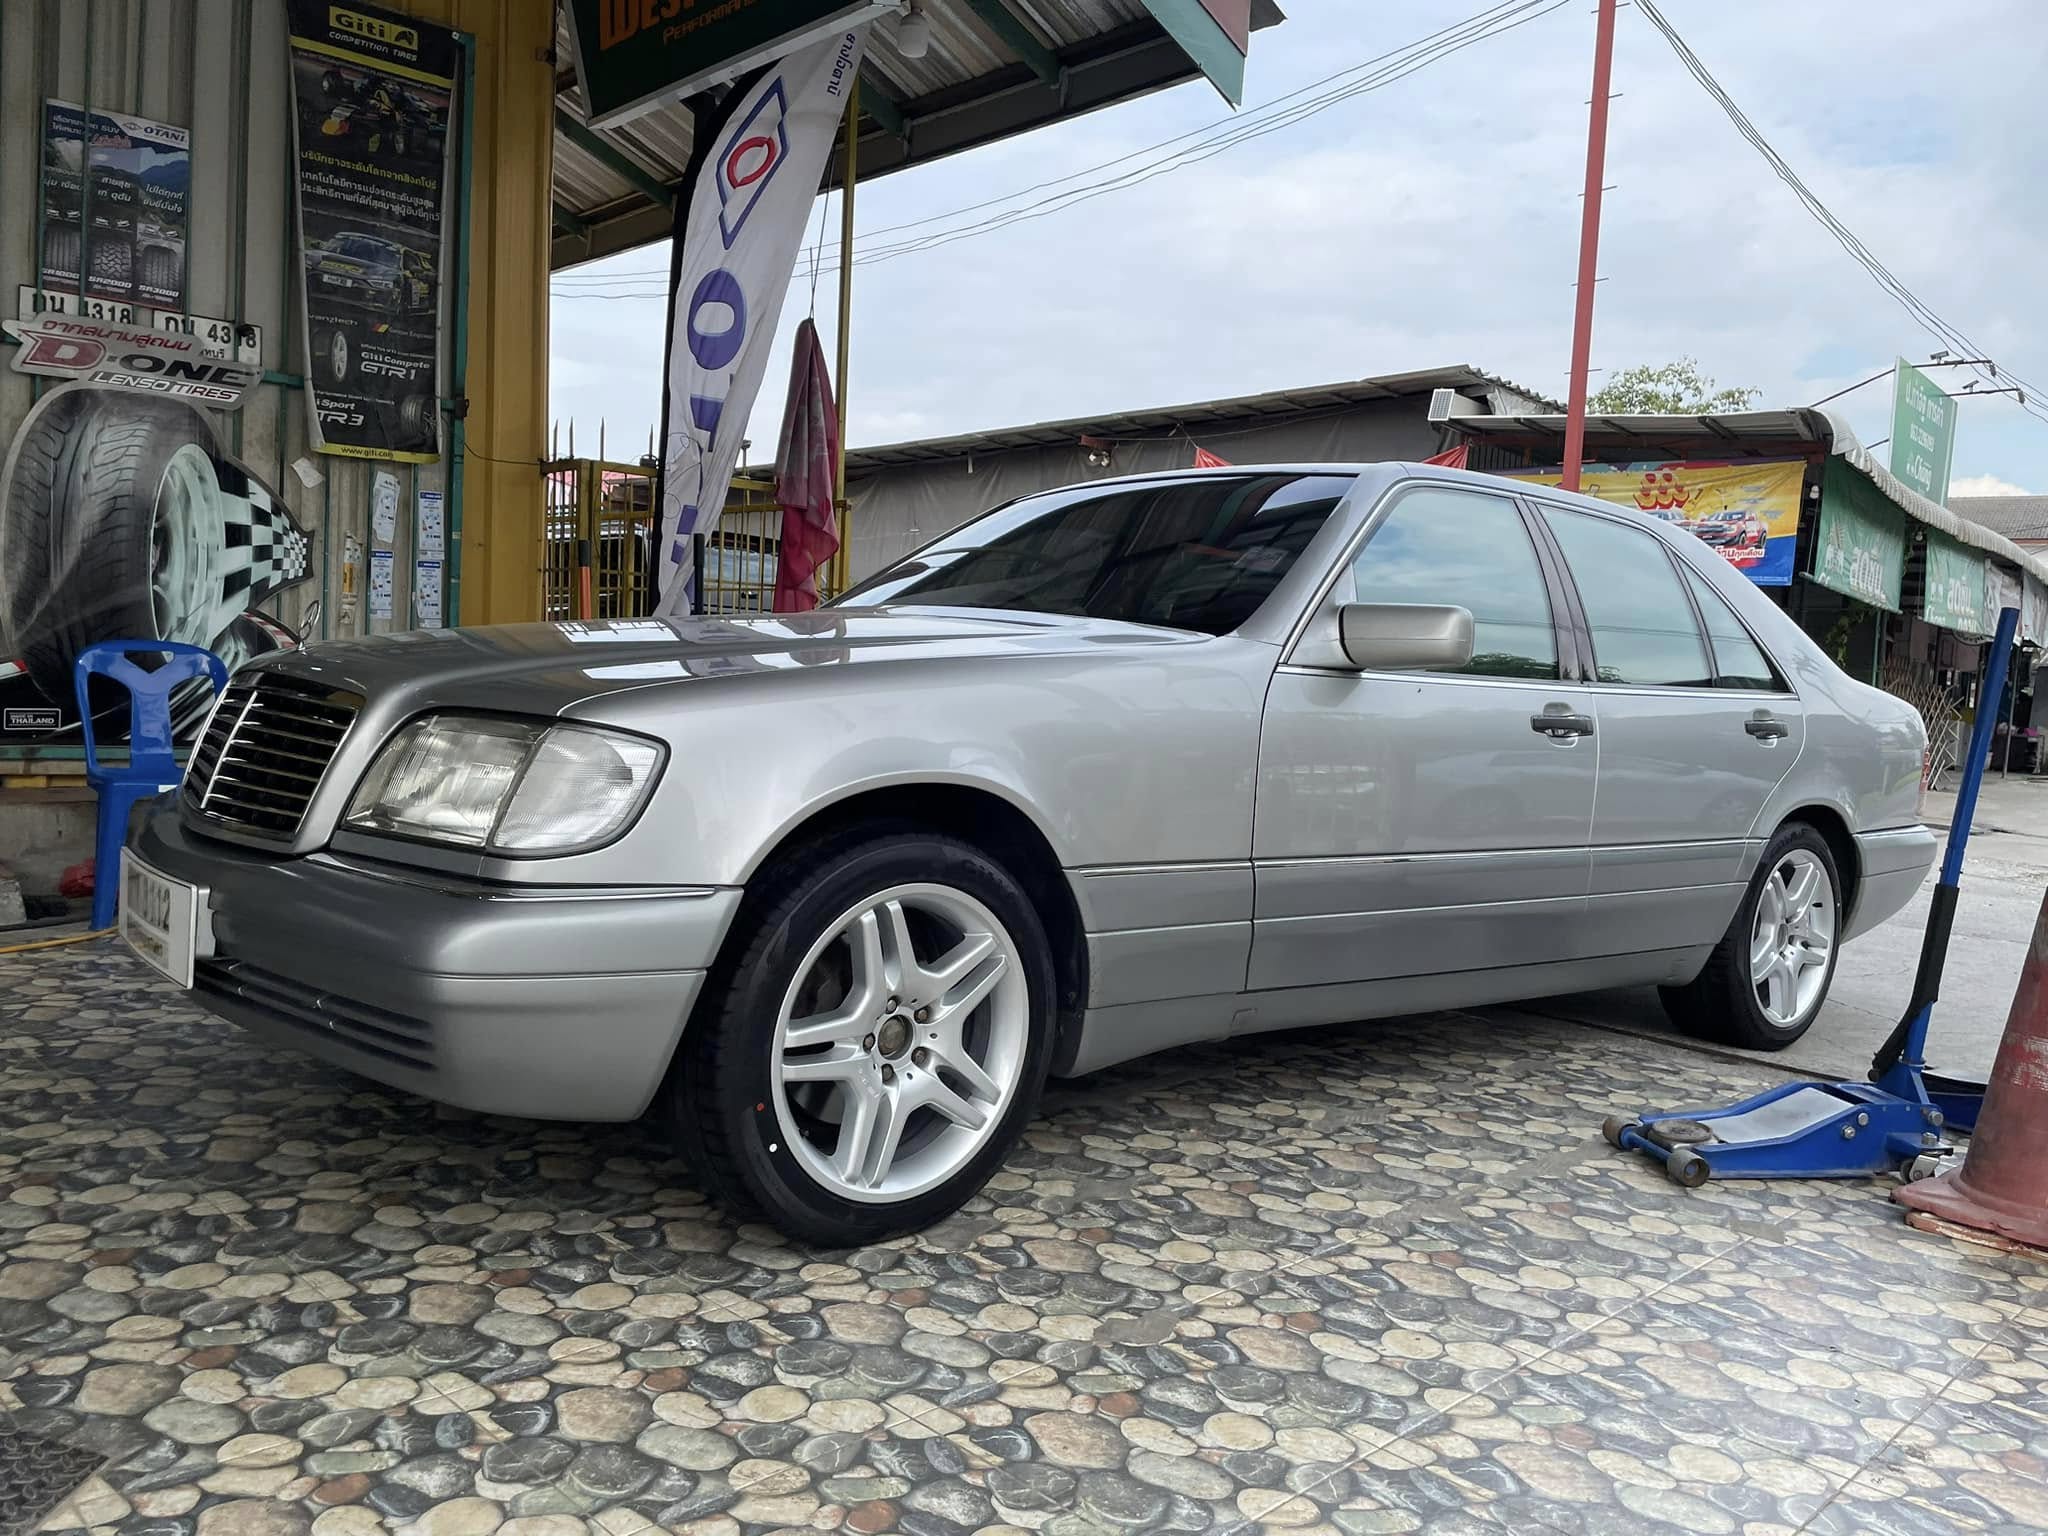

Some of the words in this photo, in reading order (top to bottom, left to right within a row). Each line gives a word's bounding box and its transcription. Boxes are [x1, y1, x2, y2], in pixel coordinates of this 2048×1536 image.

[336, 14, 385, 38] Giti
[827, 32, 856, 97] ยางโอตานิ
[144, 126, 186, 142] OTANI
[82, 300, 131, 325] 318
[41, 319, 193, 352] จากสนามสู่ถนน
[384, 355, 431, 370] Compete
[94, 371, 170, 391] LENSO
[172, 382, 236, 401] TIRES
[321, 398, 356, 410] Sport
